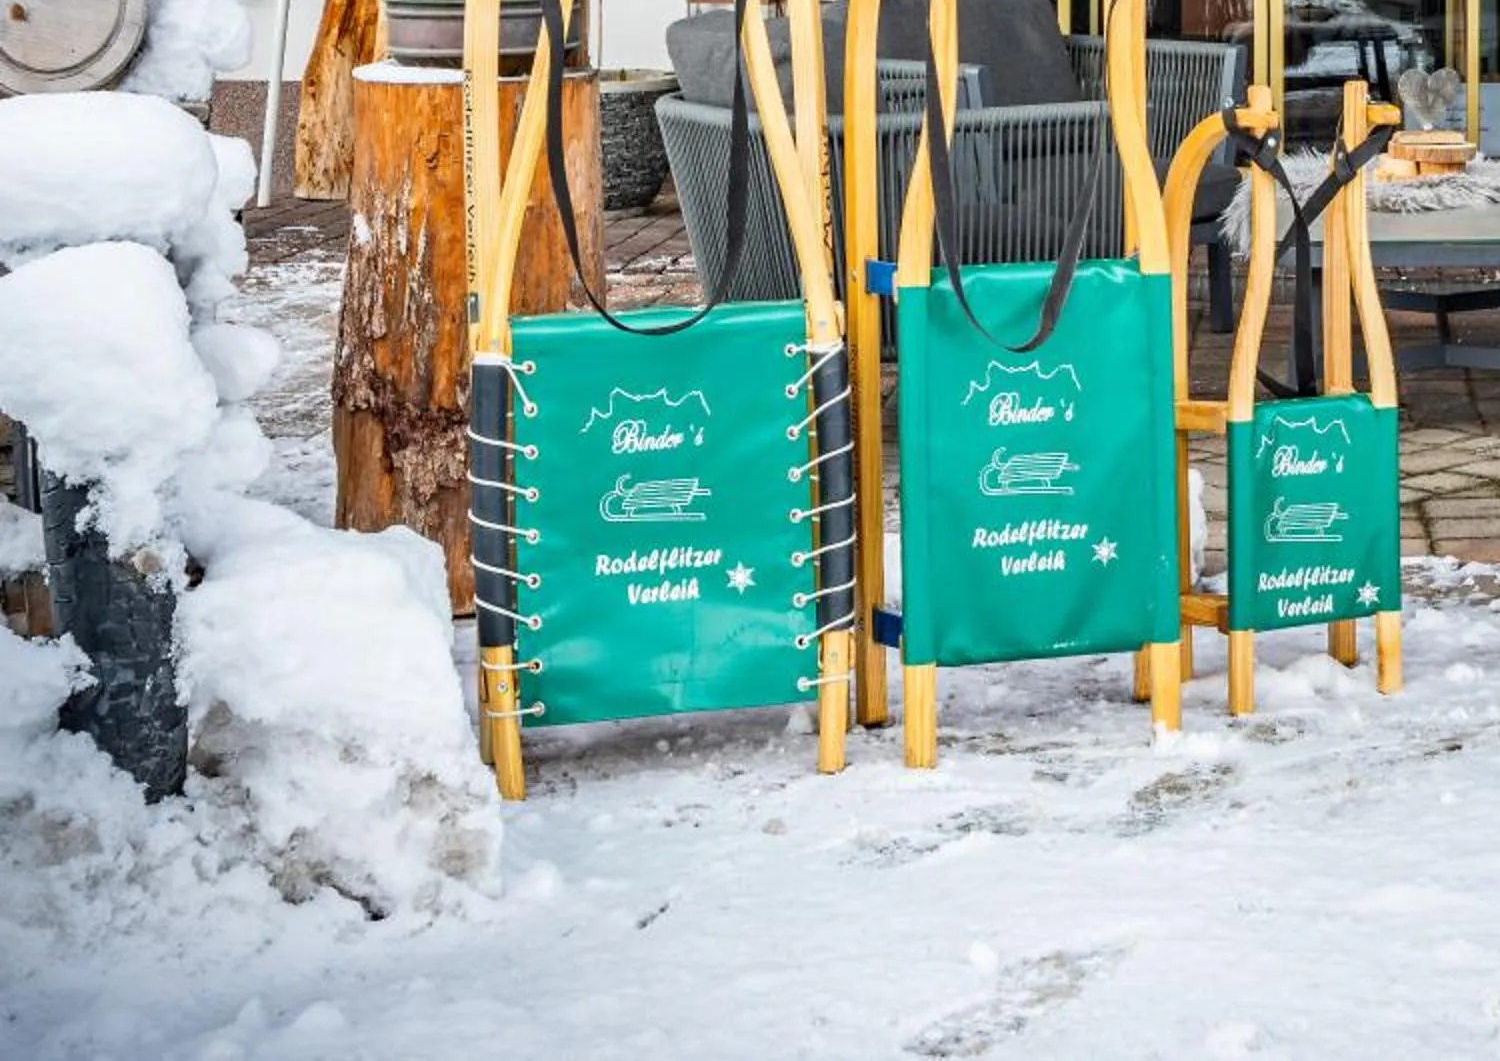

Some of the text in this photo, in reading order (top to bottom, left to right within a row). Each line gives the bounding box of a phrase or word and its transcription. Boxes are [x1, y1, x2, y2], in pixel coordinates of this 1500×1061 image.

[971, 518, 1089, 548] Rodelflitzer
[595, 545, 722, 576] Rodelflitzer
[1000, 549, 1065, 577] Verleih
[626, 576, 701, 606] Verleih
[1257, 564, 1356, 593] Rodelflitzer
[1277, 592, 1334, 619] Verleih
